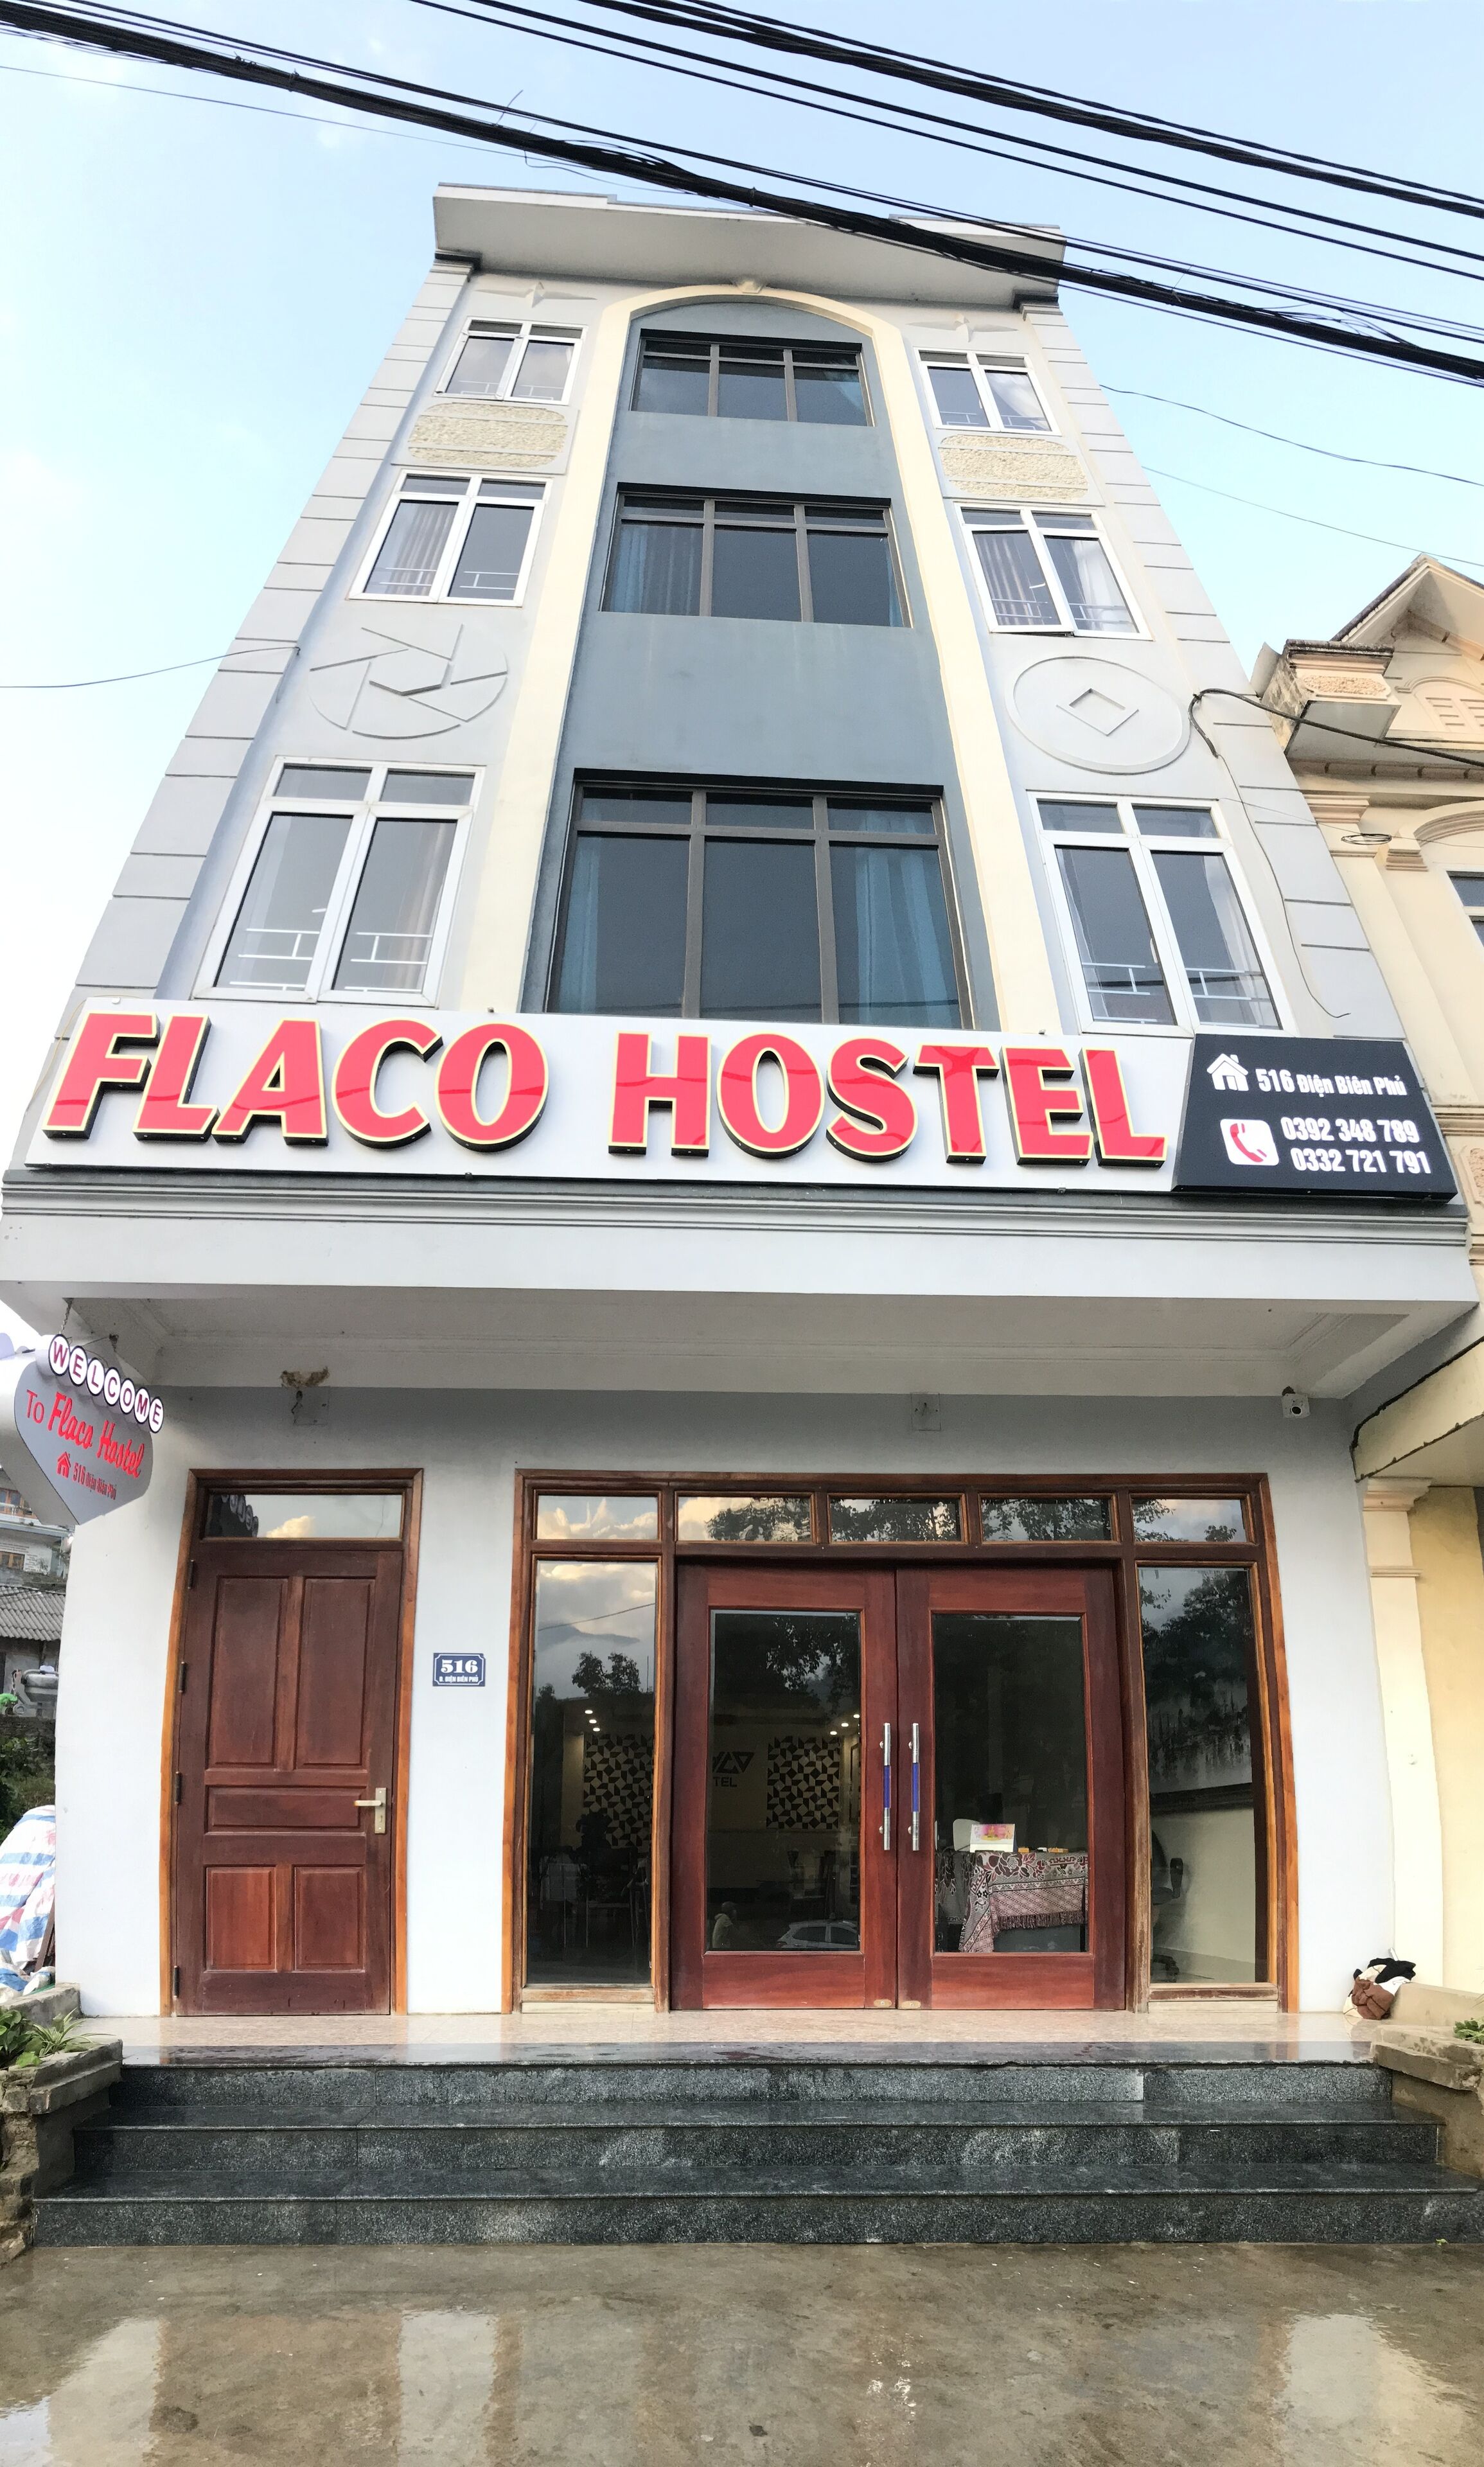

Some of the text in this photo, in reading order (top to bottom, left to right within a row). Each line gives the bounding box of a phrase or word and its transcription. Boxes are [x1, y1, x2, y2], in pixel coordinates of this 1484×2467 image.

[42, 1010, 1168, 1168] FLACO HOSTEL
[1255, 1068, 1408, 1097] 516 Điện Biên Phủ
[1280, 1117, 1421, 1144] 0392 348 789
[1289, 1147, 1433, 1174] 0332 721 791
[53, 1340, 161, 1426] WELCOME
[47, 1392, 94, 1450] Flaco
[96, 1420, 145, 1479] Hostel
[73, 1462, 86, 1485] 516
[441, 1659, 478, 1674] 516
